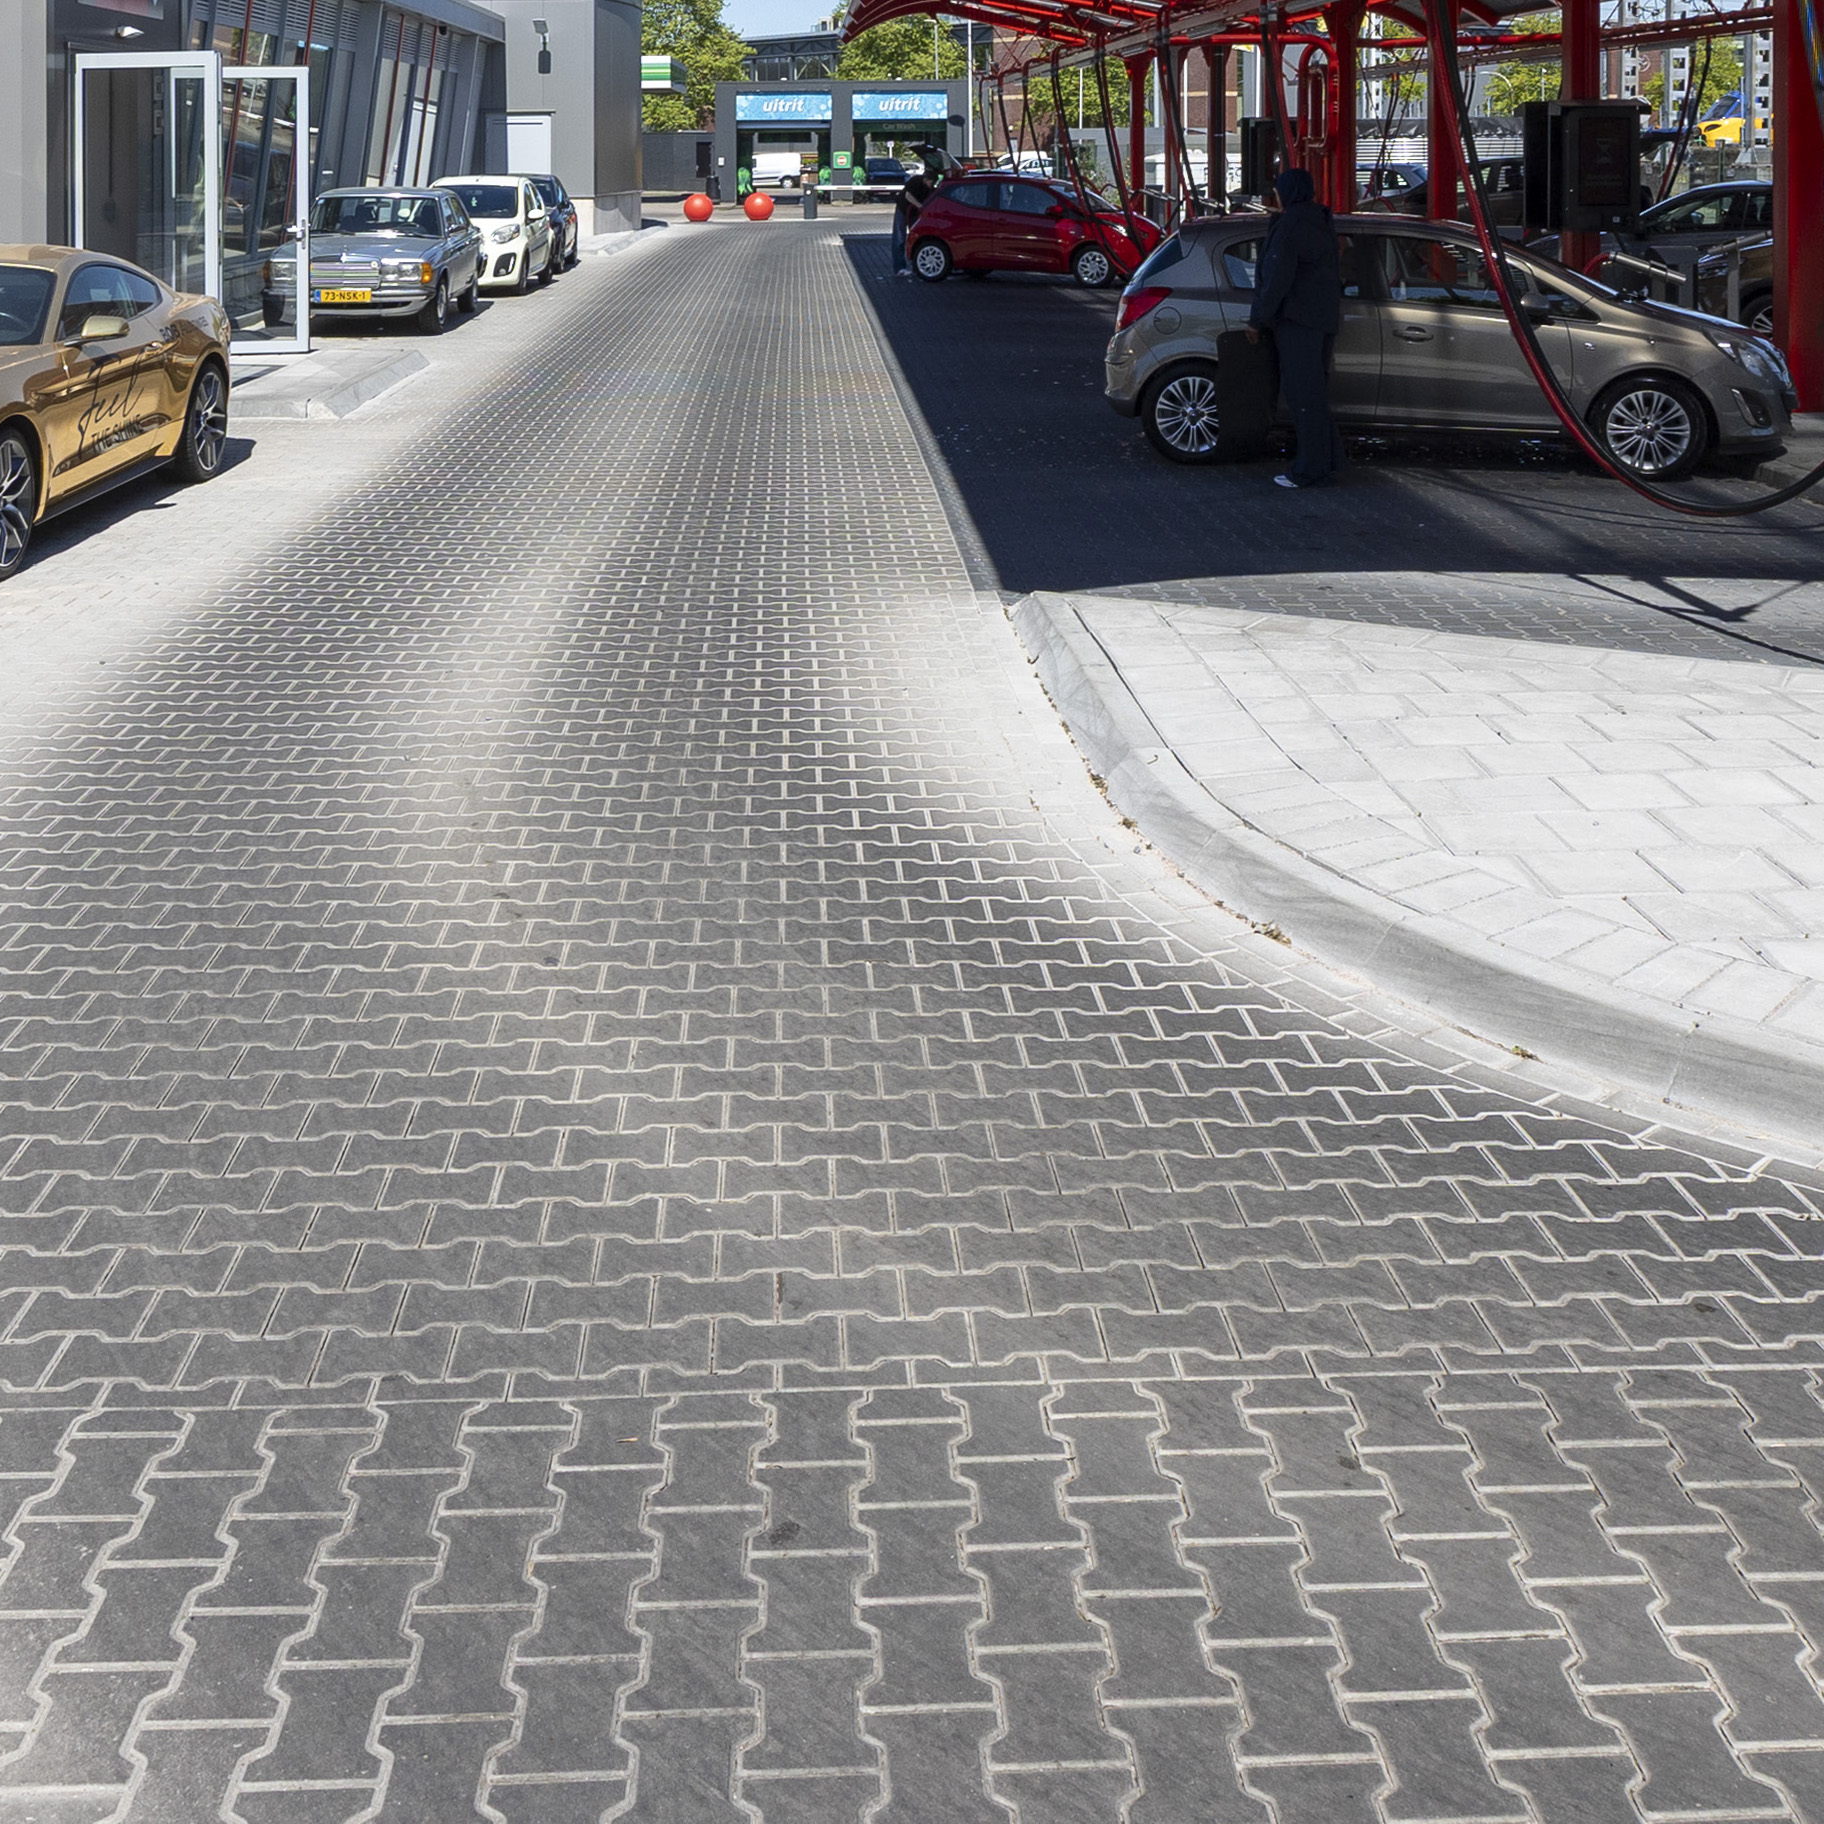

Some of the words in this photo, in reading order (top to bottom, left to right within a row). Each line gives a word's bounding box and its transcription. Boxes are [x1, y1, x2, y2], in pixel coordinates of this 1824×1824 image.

[762, 97, 805, 113] uitrit
[878, 96, 921, 112] uitrit
[324, 291, 367, 301] 73-NSK-1
